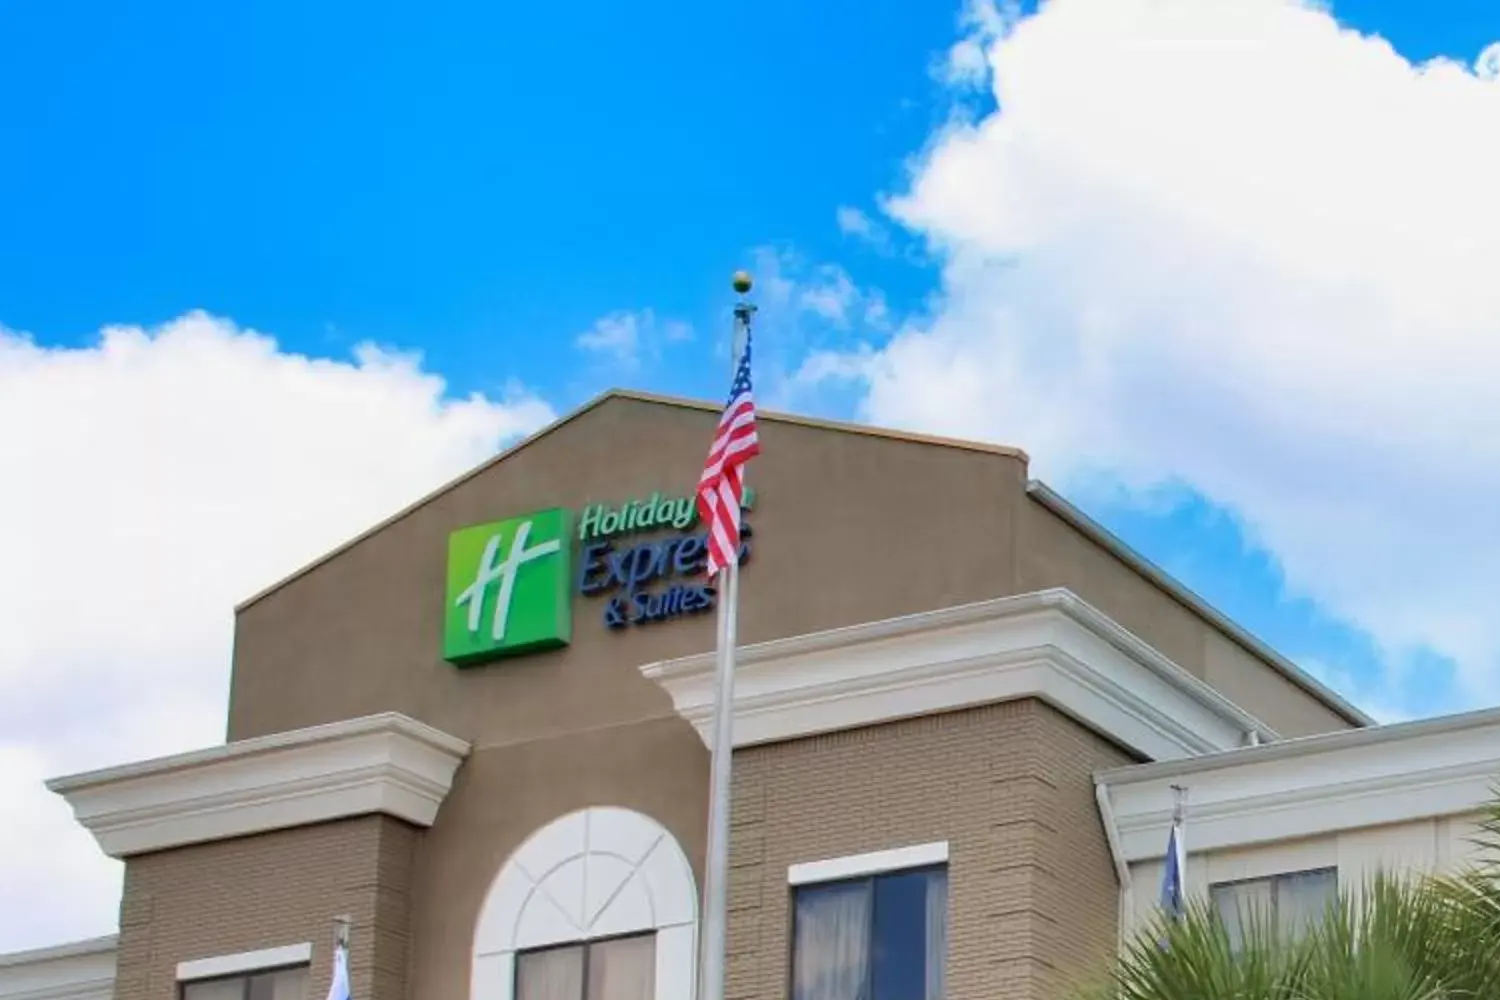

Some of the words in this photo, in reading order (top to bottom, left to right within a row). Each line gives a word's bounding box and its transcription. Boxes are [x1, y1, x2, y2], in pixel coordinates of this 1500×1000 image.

[579, 492, 697, 540] Holiday
[578, 530, 752, 597] Expre
[605, 597, 624, 627] &
[628, 584, 715, 623] Suites
